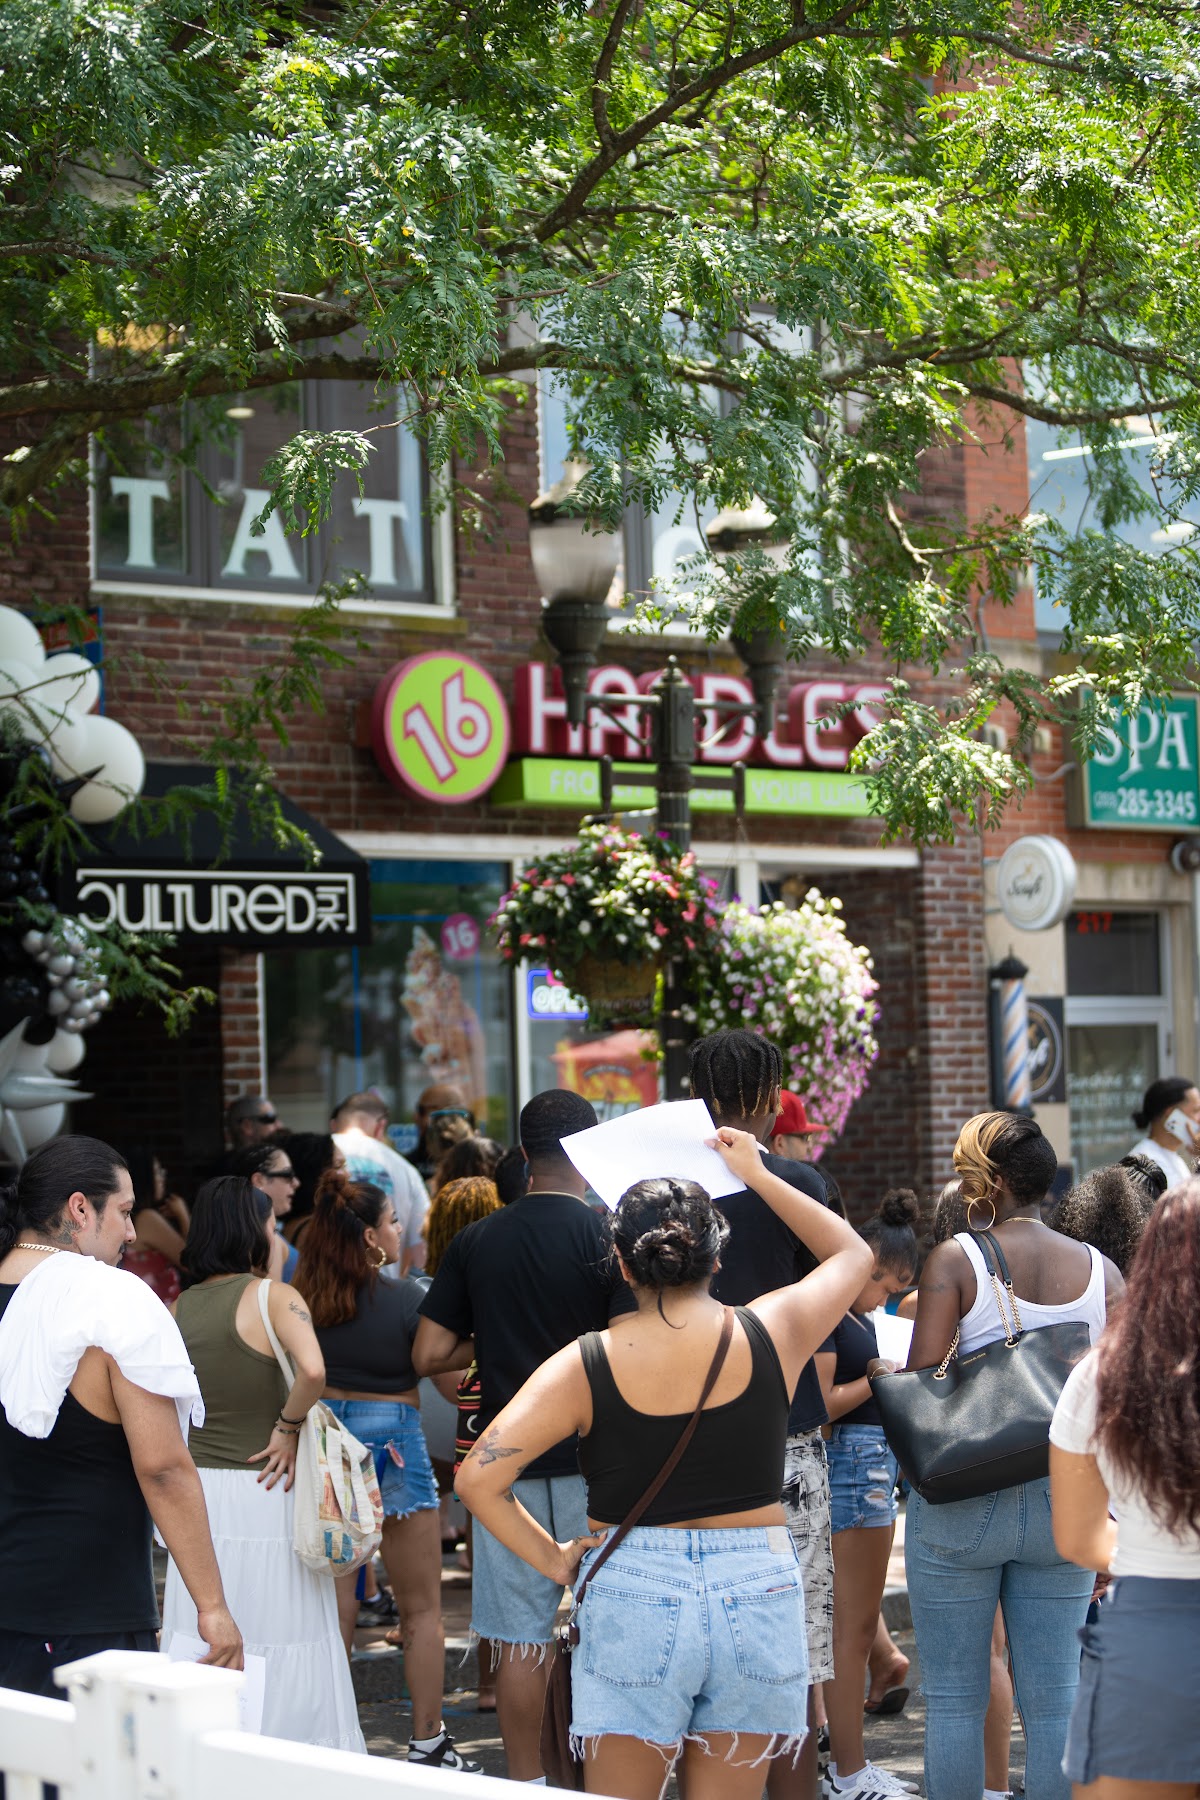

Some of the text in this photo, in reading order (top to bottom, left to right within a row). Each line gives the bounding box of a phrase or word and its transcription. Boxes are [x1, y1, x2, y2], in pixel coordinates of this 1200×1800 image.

[403, 661, 897, 784] 16 HADLES
[1093, 704, 1192, 782] SPA
[445, 920, 475, 952] 16
